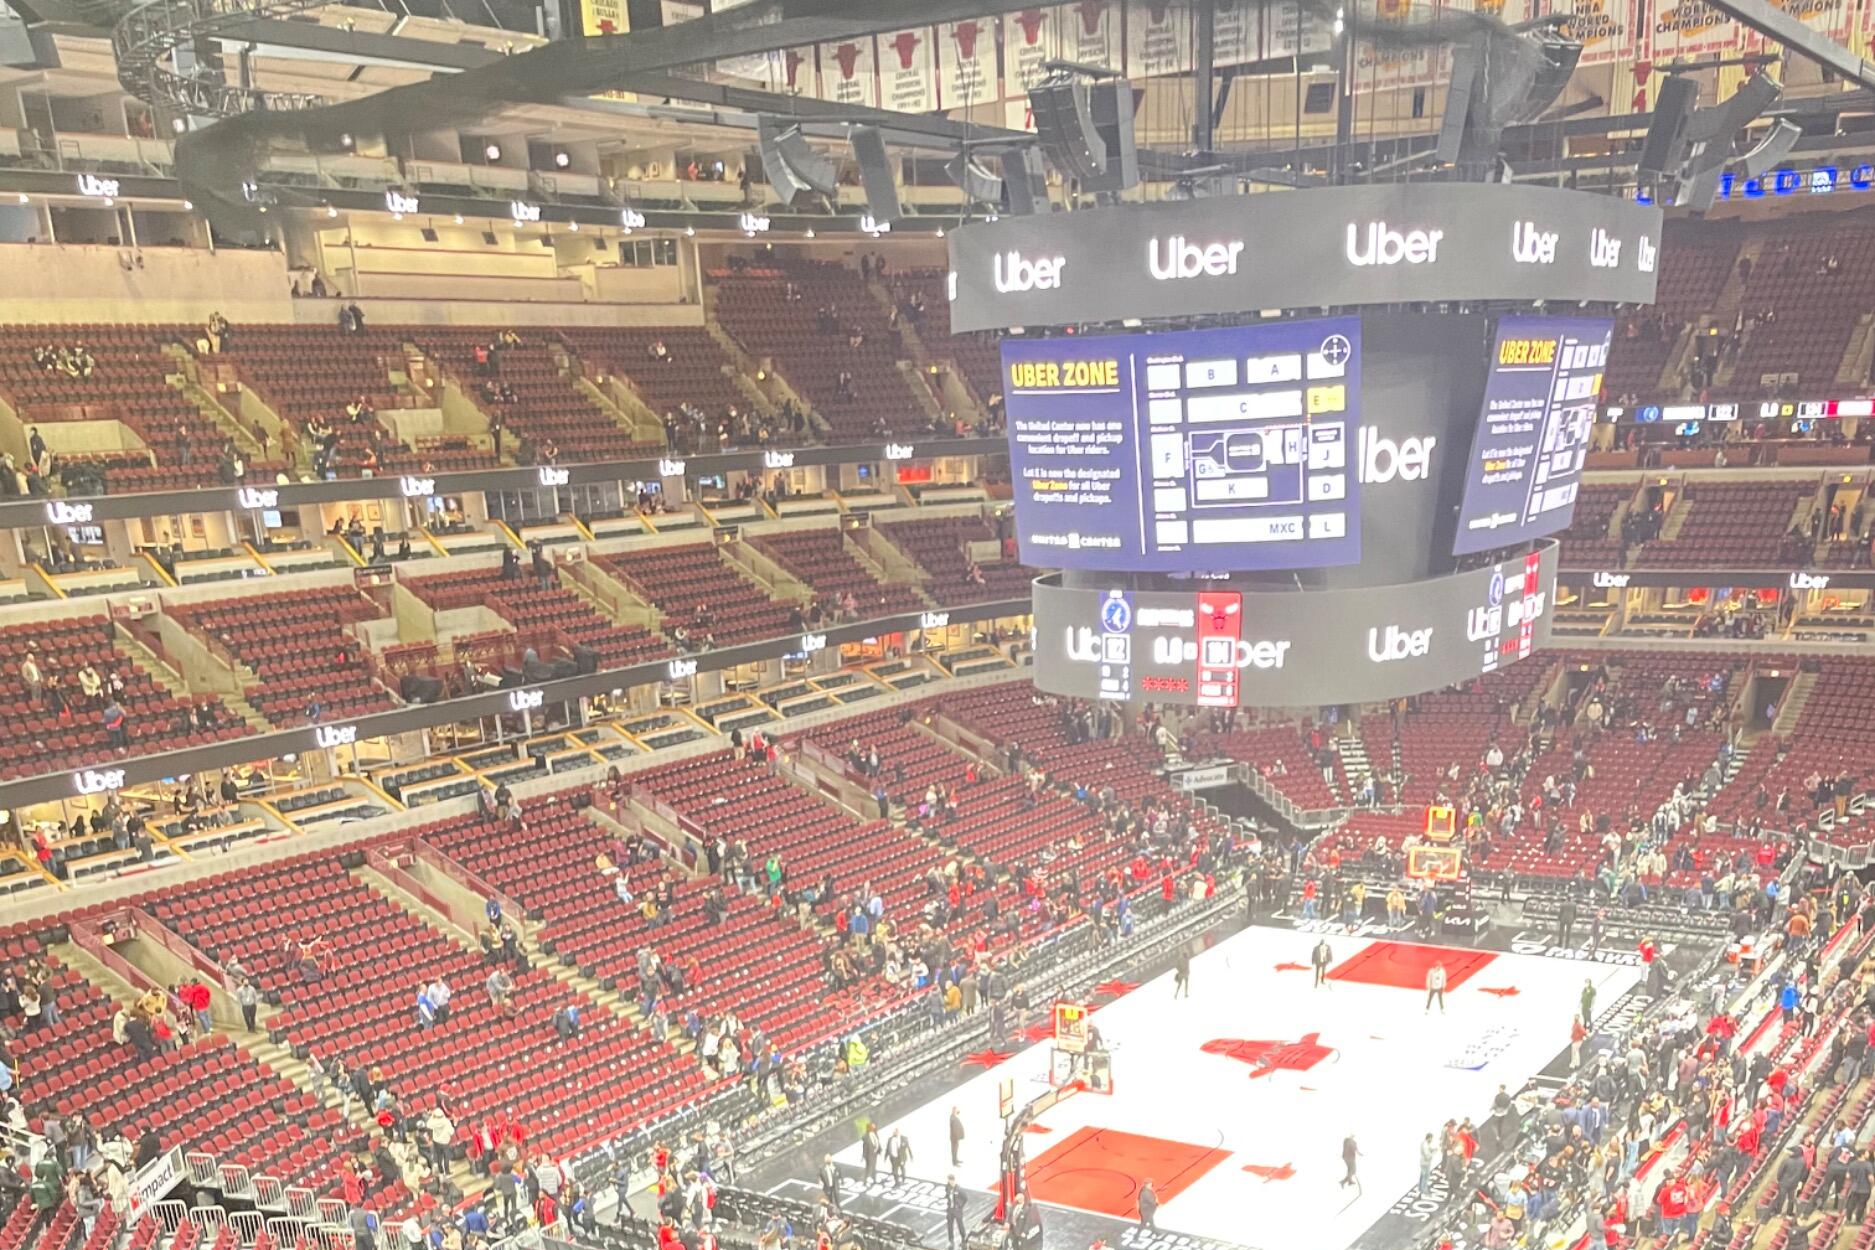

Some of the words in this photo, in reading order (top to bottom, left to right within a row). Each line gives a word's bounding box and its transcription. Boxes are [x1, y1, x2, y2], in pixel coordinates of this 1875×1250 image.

[77, 174, 119, 197] Uber
[386, 191, 419, 213] Uber
[511, 201, 540, 221] Uber
[741, 213, 771, 231] Uber
[1346, 221, 1444, 267] Uber
[1512, 220, 1559, 264] Uber
[1591, 227, 1622, 268] Uber
[1148, 235, 1245, 281] Uber
[993, 250, 1066, 294] Uber
[1500, 340, 1528, 364] UBER
[1529, 340, 1556, 363] ZONE
[1011, 362, 1060, 387] UBER
[1063, 361, 1119, 386] ZONE
[1207, 369, 1215, 380] B
[1271, 364, 1280, 376] A
[1239, 402, 1248, 413] C
[885, 443, 914, 460] Uber
[1288, 441, 1297, 452] H
[765, 451, 794, 468] Uber
[1165, 453, 1172, 463] F
[540, 466, 569, 486] Uber
[660, 459, 686, 477] Uber
[401, 476, 435, 497] Uber
[1228, 483, 1236, 494] K
[1322, 483, 1331, 494] D
[238, 487, 279, 508] Uber
[46, 501, 93, 524] Uber
[1269, 522, 1296, 534] MXC
[1324, 521, 1331, 532] L
[1593, 572, 1630, 588] Uber
[1790, 572, 1830, 589] Uber
[921, 611, 949, 629] Uber
[802, 635, 827, 650] Uber
[1368, 624, 1434, 663] Uber
[670, 660, 698, 679] Uber
[510, 690, 544, 710] Uber
[316, 726, 357, 748] Uber
[75, 769, 125, 794] Uber
